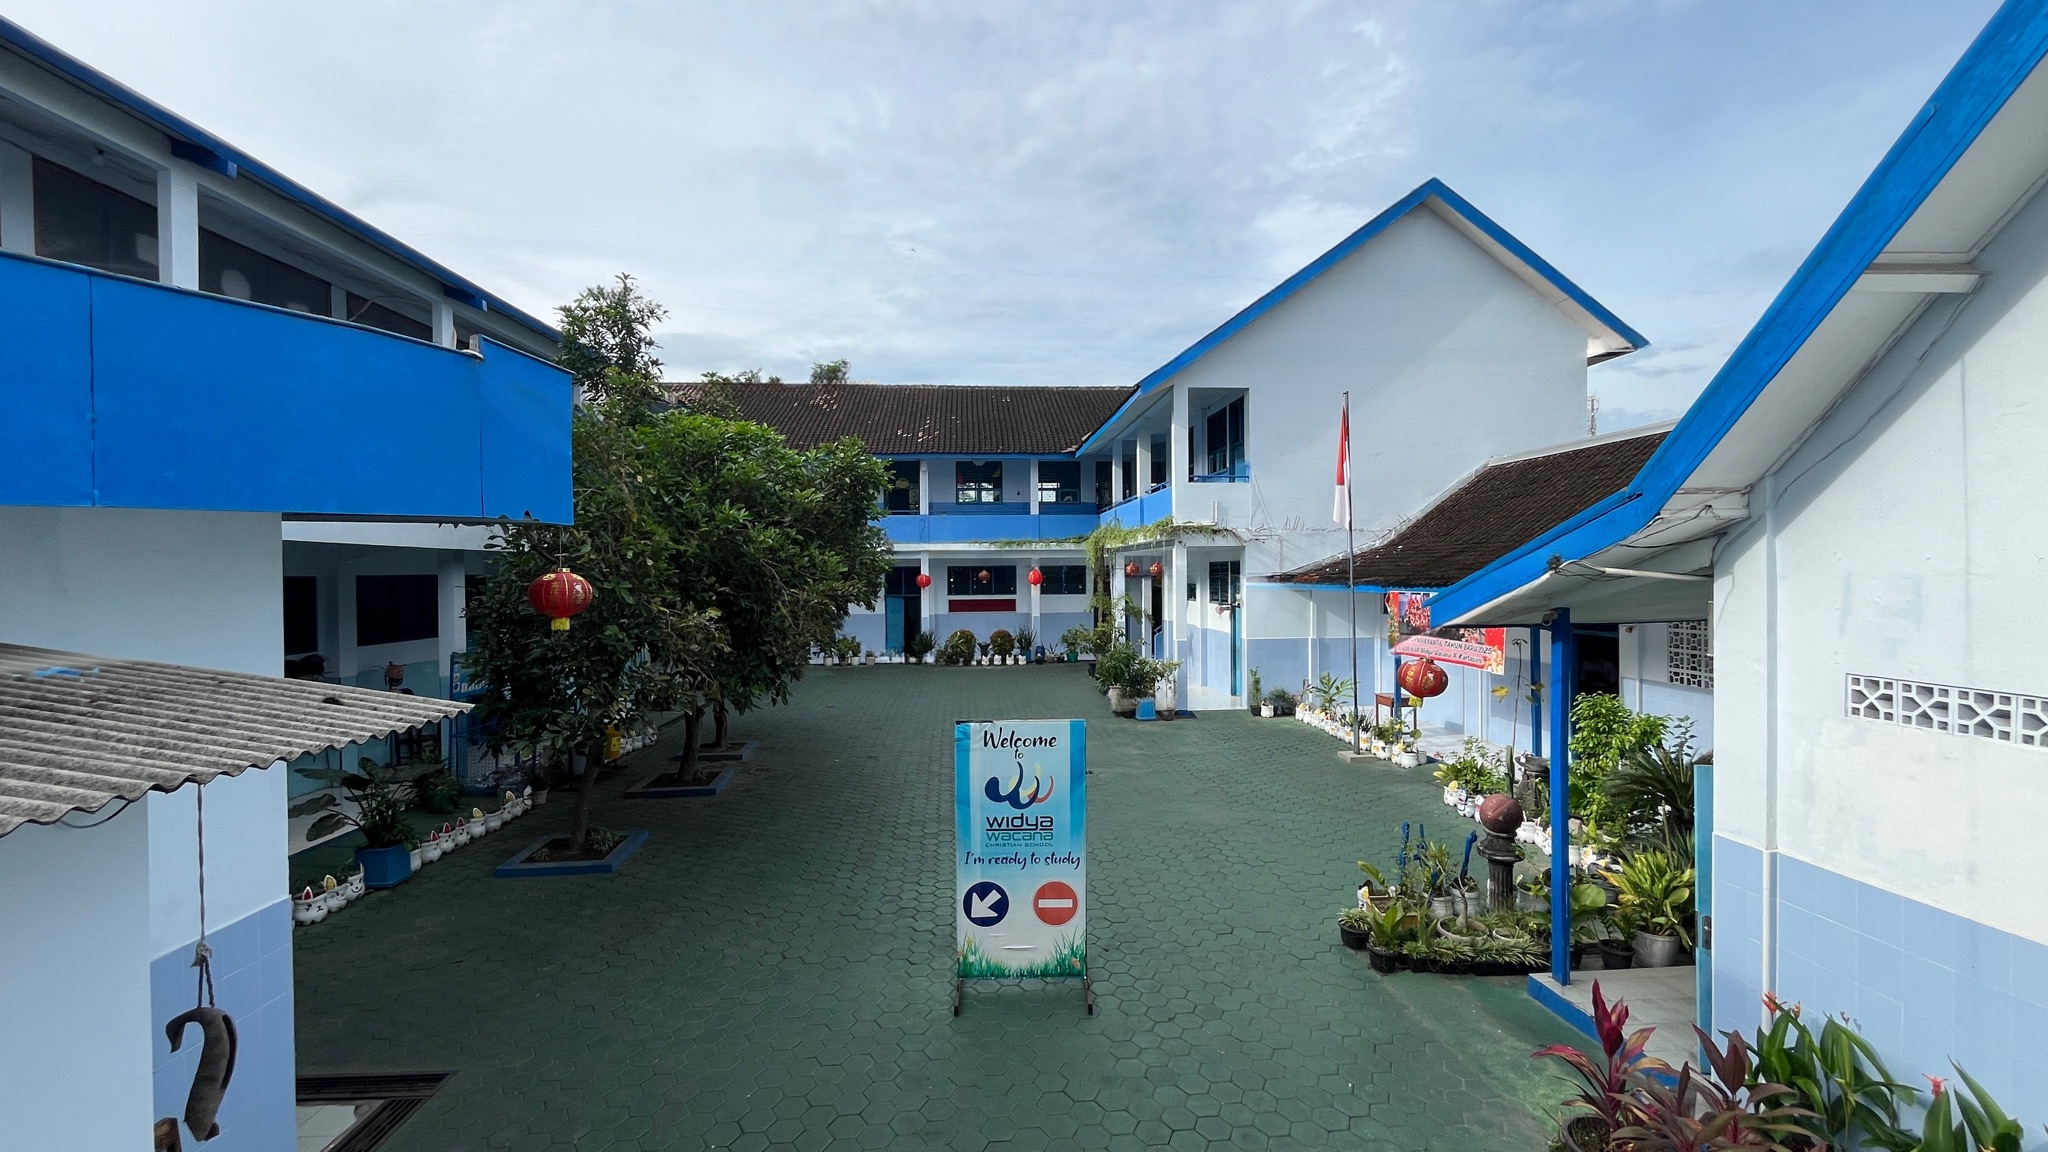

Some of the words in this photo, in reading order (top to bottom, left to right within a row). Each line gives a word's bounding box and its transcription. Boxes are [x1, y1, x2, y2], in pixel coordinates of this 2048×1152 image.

[1444, 640, 1462, 650] TAHUN
[983, 727, 1057, 748] Welcome
[1014, 748, 1024, 760] to
[986, 812, 1054, 831] widya
[986, 832, 1054, 842] wacana
[964, 851, 985, 865] I'm
[988, 851, 1027, 870] ready
[1030, 851, 1041, 865] to
[1044, 851, 1081, 870] study
